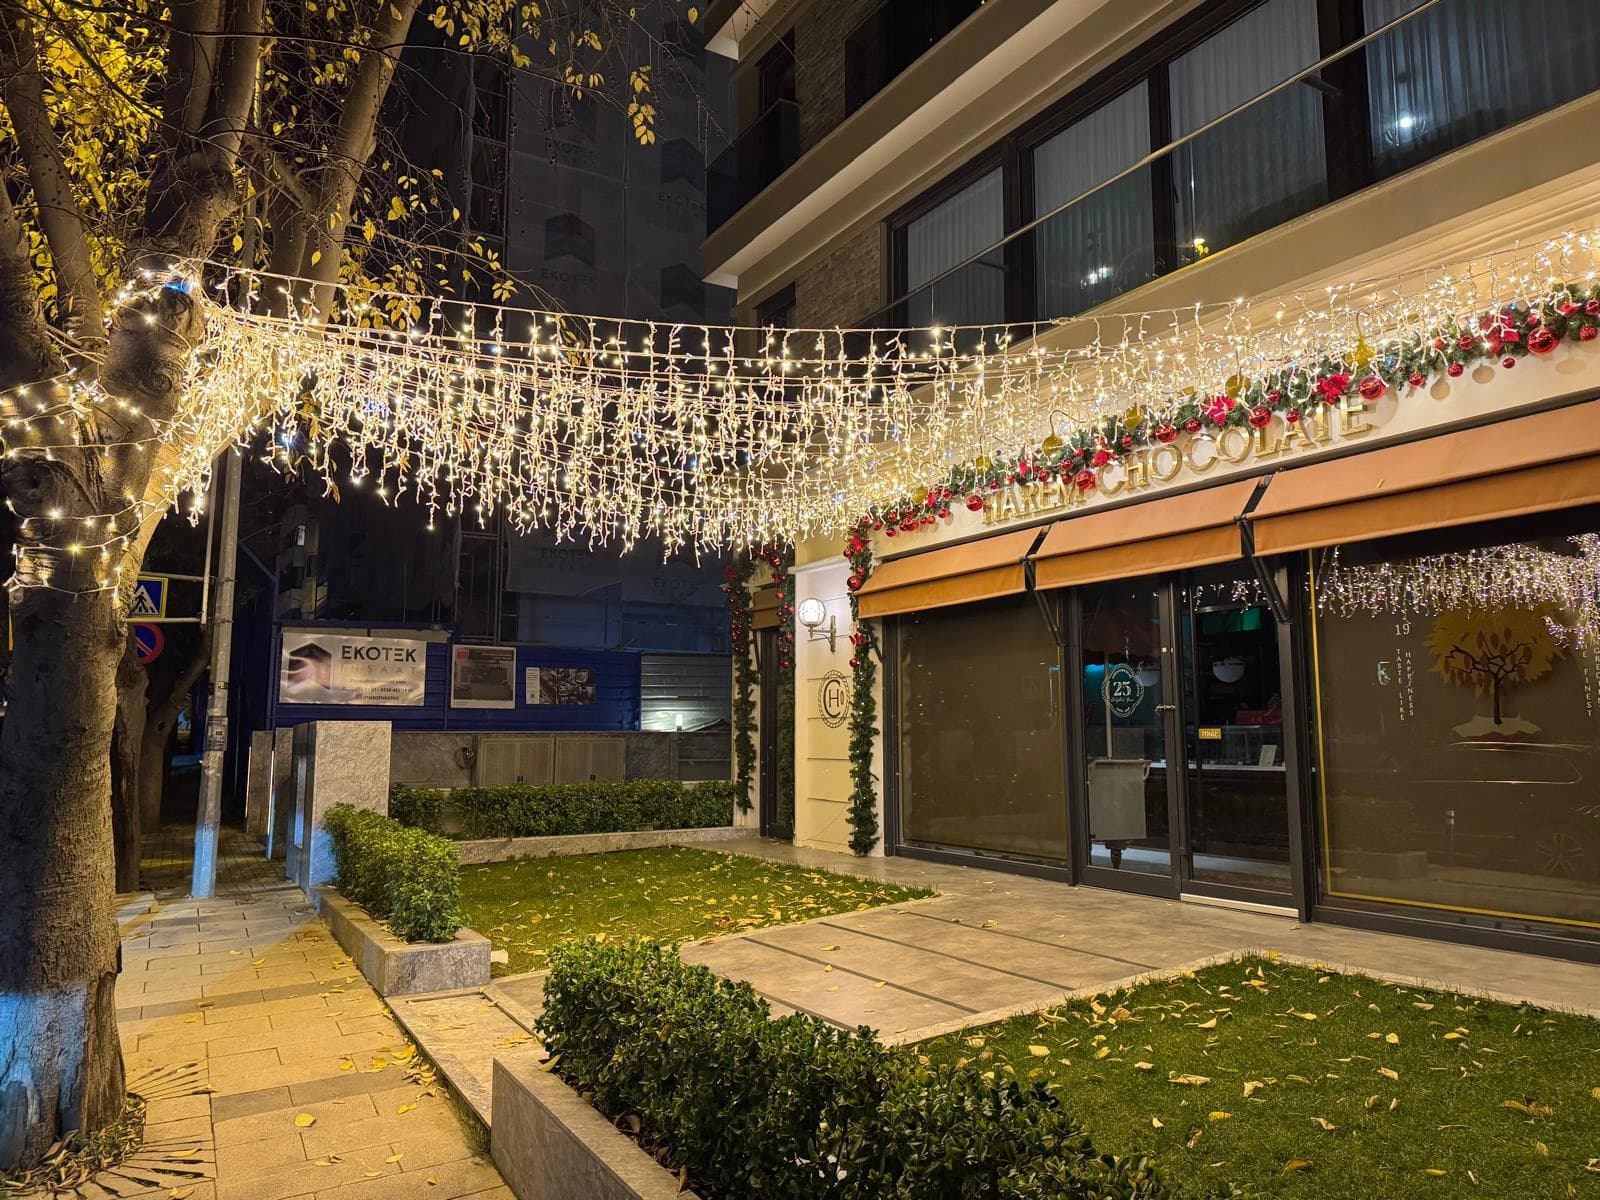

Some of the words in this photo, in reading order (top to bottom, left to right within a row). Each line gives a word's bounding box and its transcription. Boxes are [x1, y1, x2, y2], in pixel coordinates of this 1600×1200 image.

[1097, 394, 1374, 495] CHOCOLATE
[1394, 623, 1410, 636] 19
[341, 644, 417, 663] EKOTEK
[1112, 681, 1132, 697] 25
[1405, 651, 1414, 716] HAPPINESS
[1583, 668, 1593, 718] FINEST
